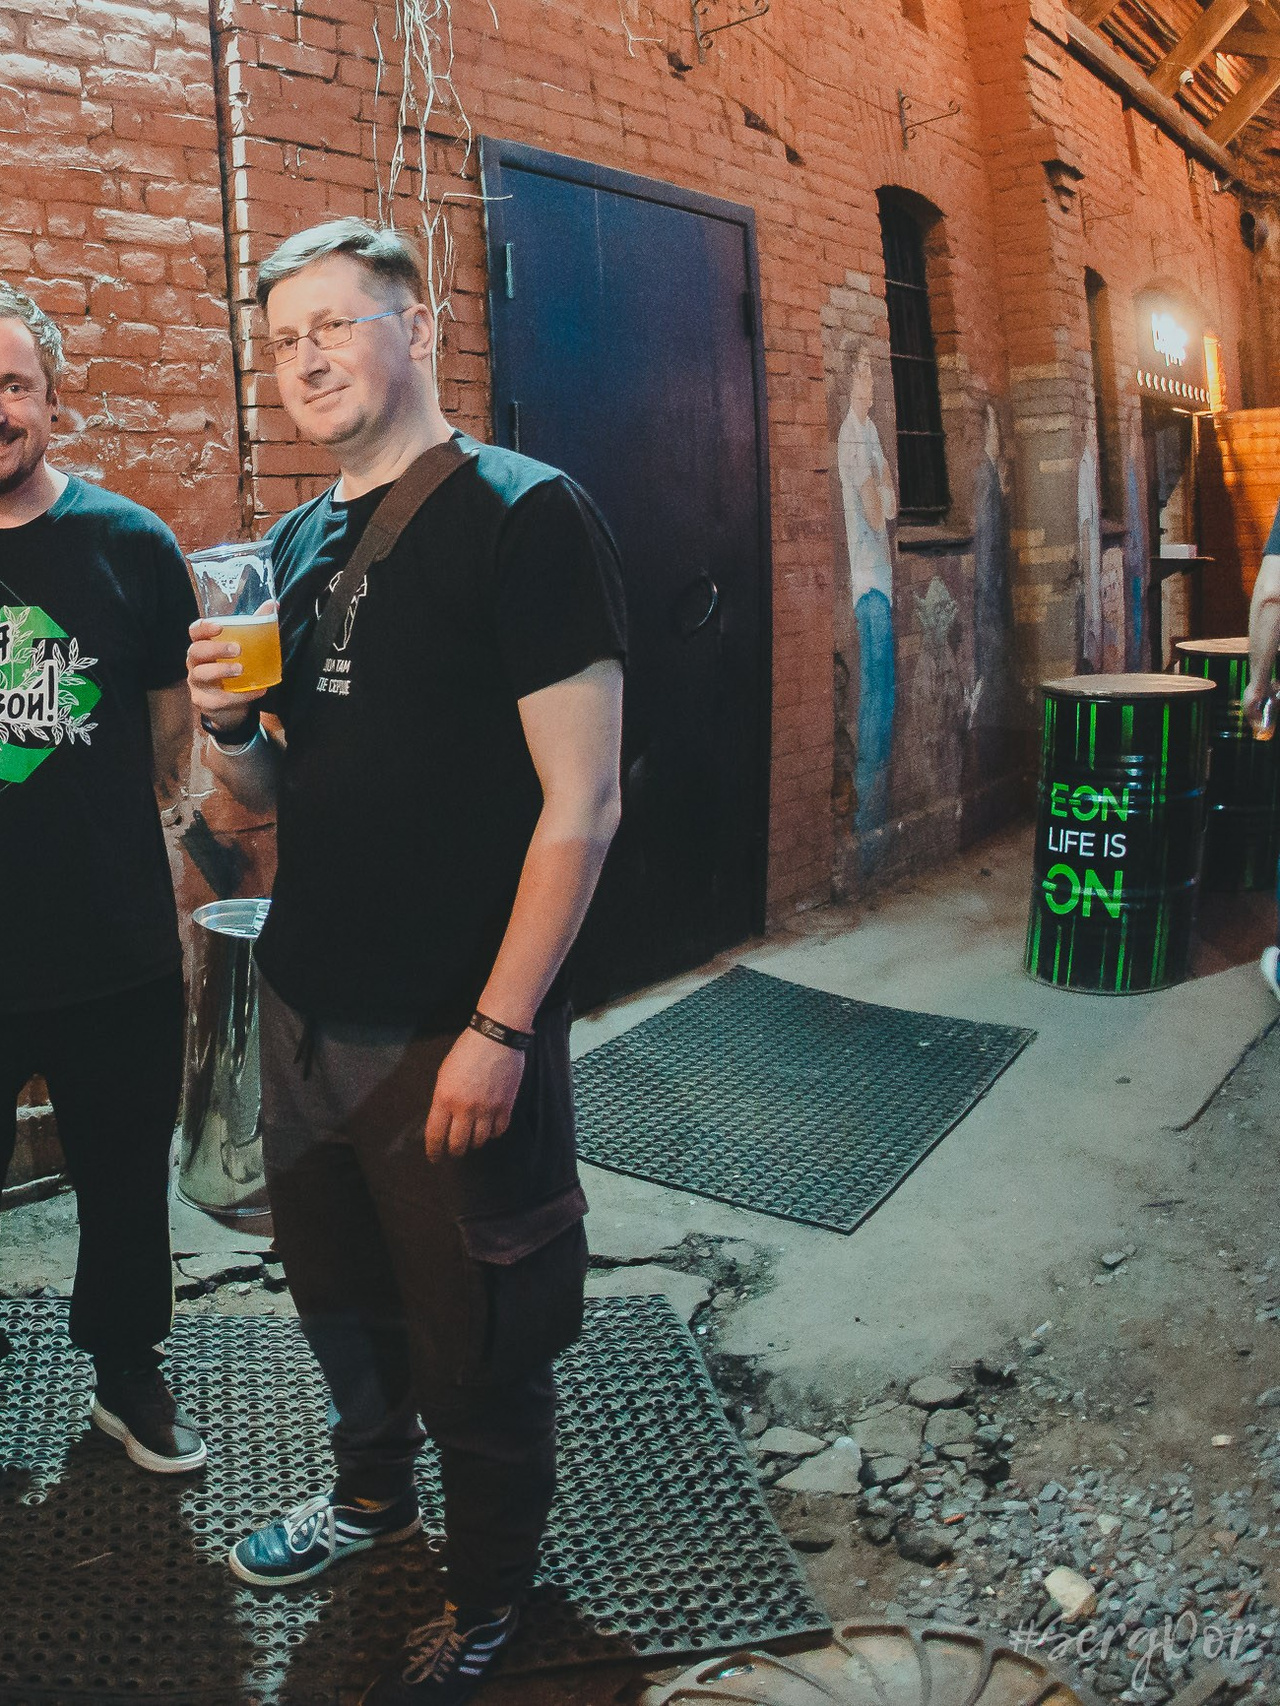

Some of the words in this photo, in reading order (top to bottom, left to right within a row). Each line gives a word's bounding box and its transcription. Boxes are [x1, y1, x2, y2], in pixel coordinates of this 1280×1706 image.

[1048, 826, 1096, 858] LIFE
[1103, 833, 1127, 859] IS
[1041, 863, 1124, 919] ON
